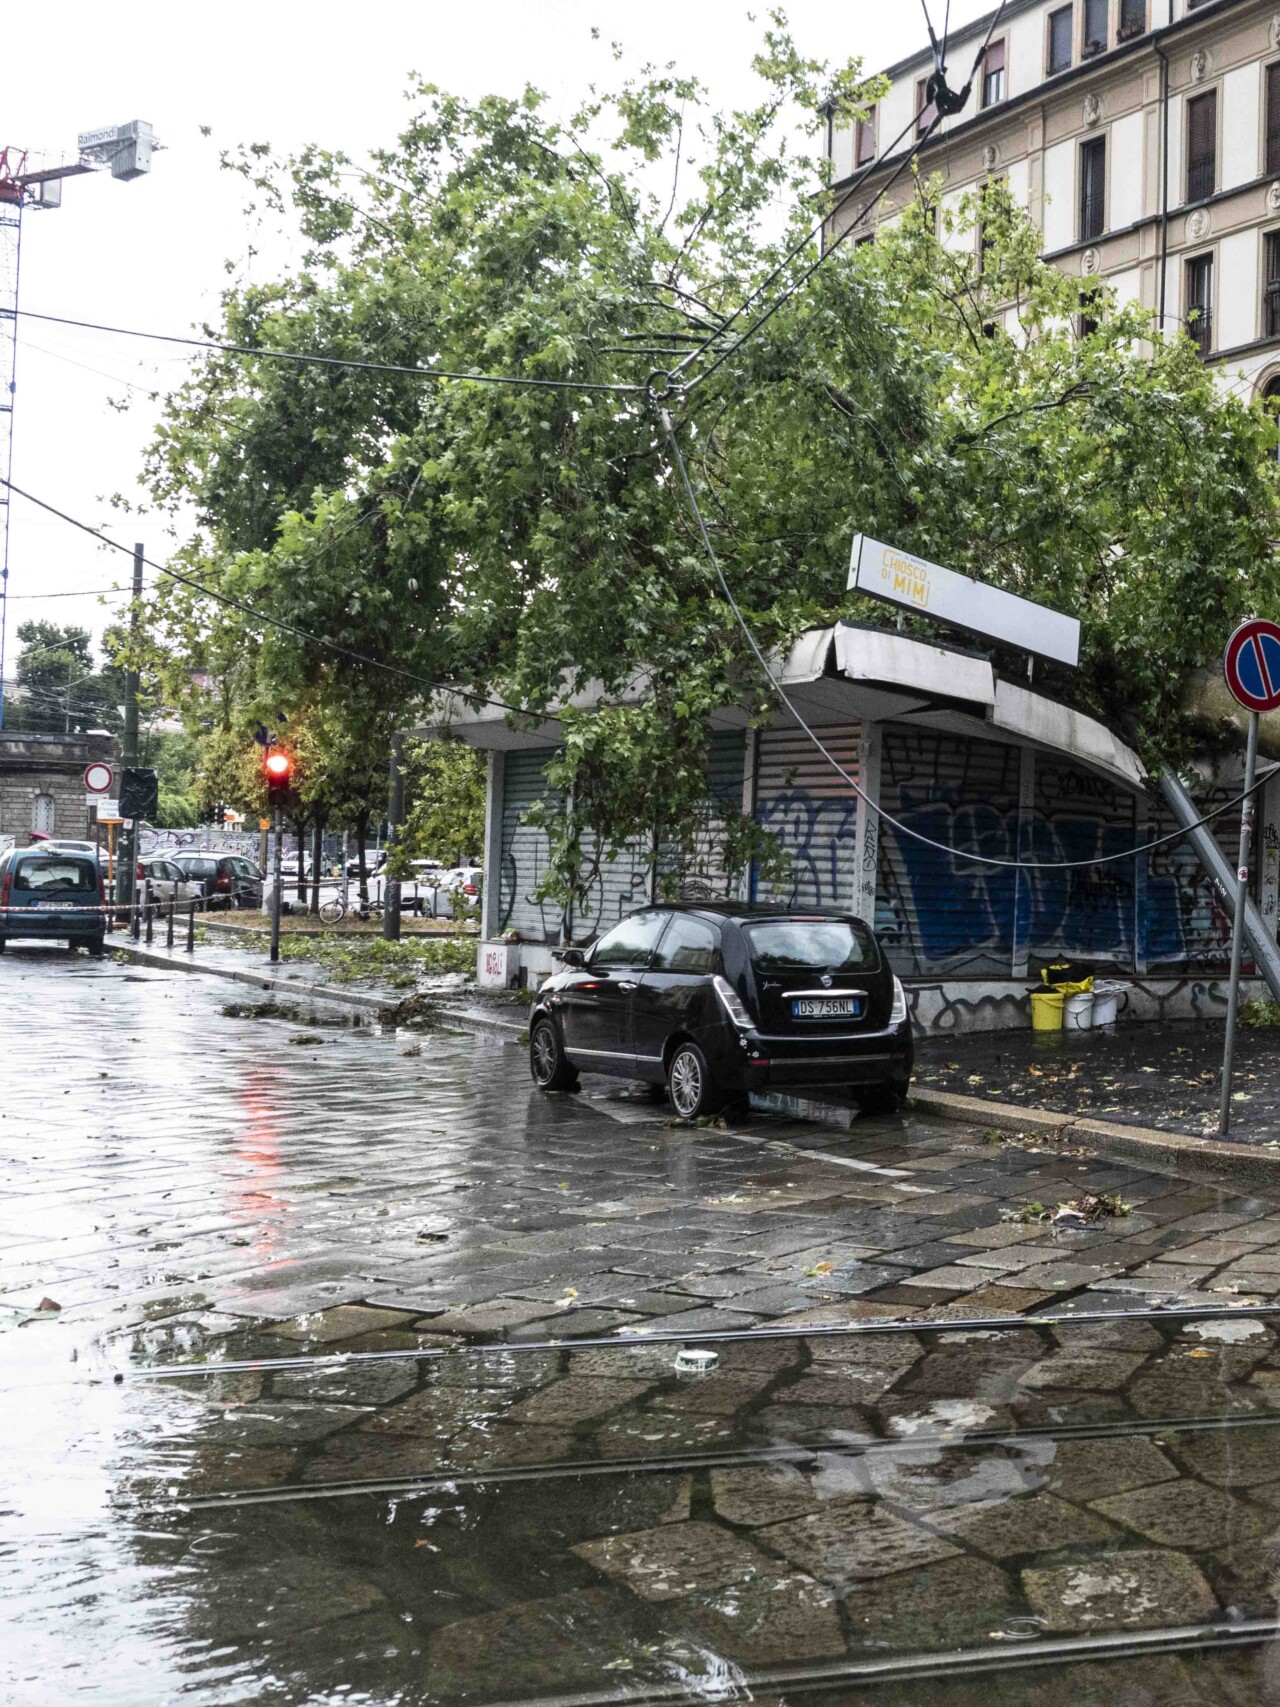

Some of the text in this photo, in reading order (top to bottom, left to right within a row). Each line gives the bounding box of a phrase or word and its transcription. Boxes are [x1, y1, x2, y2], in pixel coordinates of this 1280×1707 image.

[882, 548, 927, 582] CHIOSCO
[800, 1000, 852, 1014] DS 756NL
